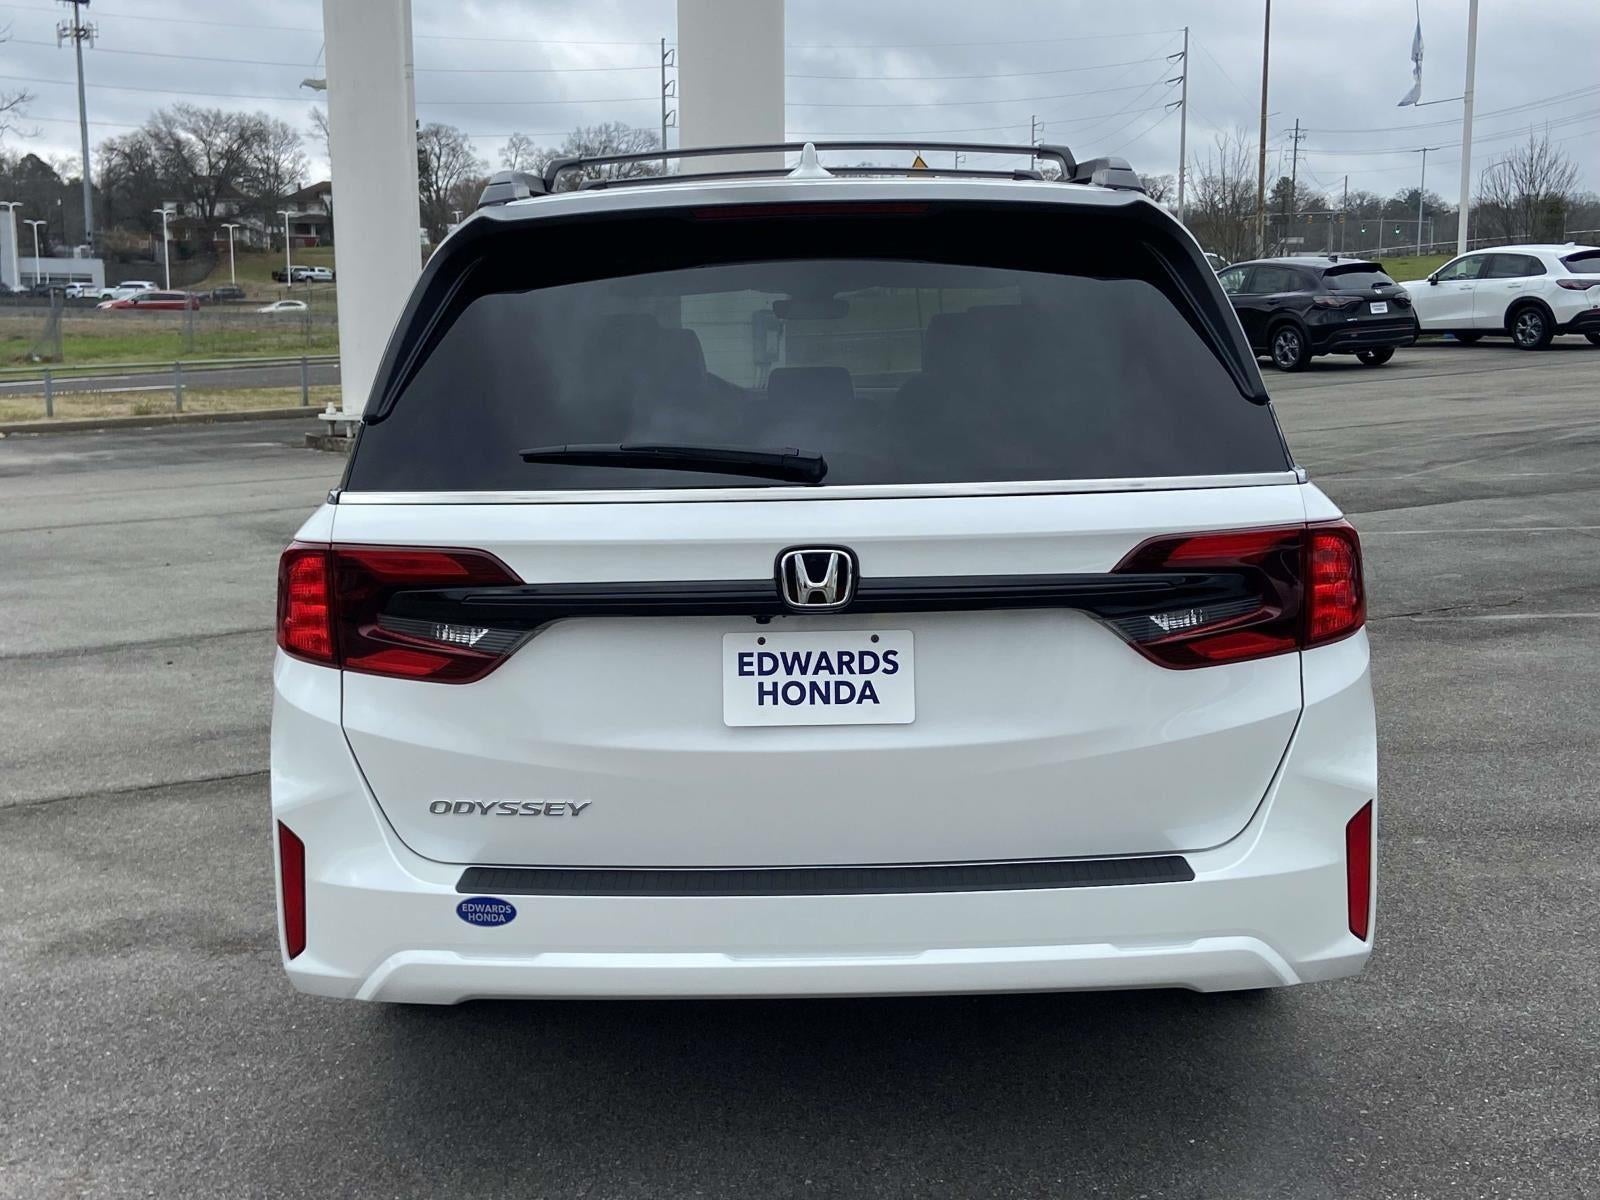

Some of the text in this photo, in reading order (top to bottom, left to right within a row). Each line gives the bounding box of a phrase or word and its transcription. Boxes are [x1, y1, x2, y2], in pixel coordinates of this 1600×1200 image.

[738, 650, 899, 676] EDWARDS
[757, 680, 880, 706] HONDA
[429, 800, 592, 817] ODYSSEY
[462, 903, 512, 914] EDWARDS
[468, 913, 506, 923] HONDA
